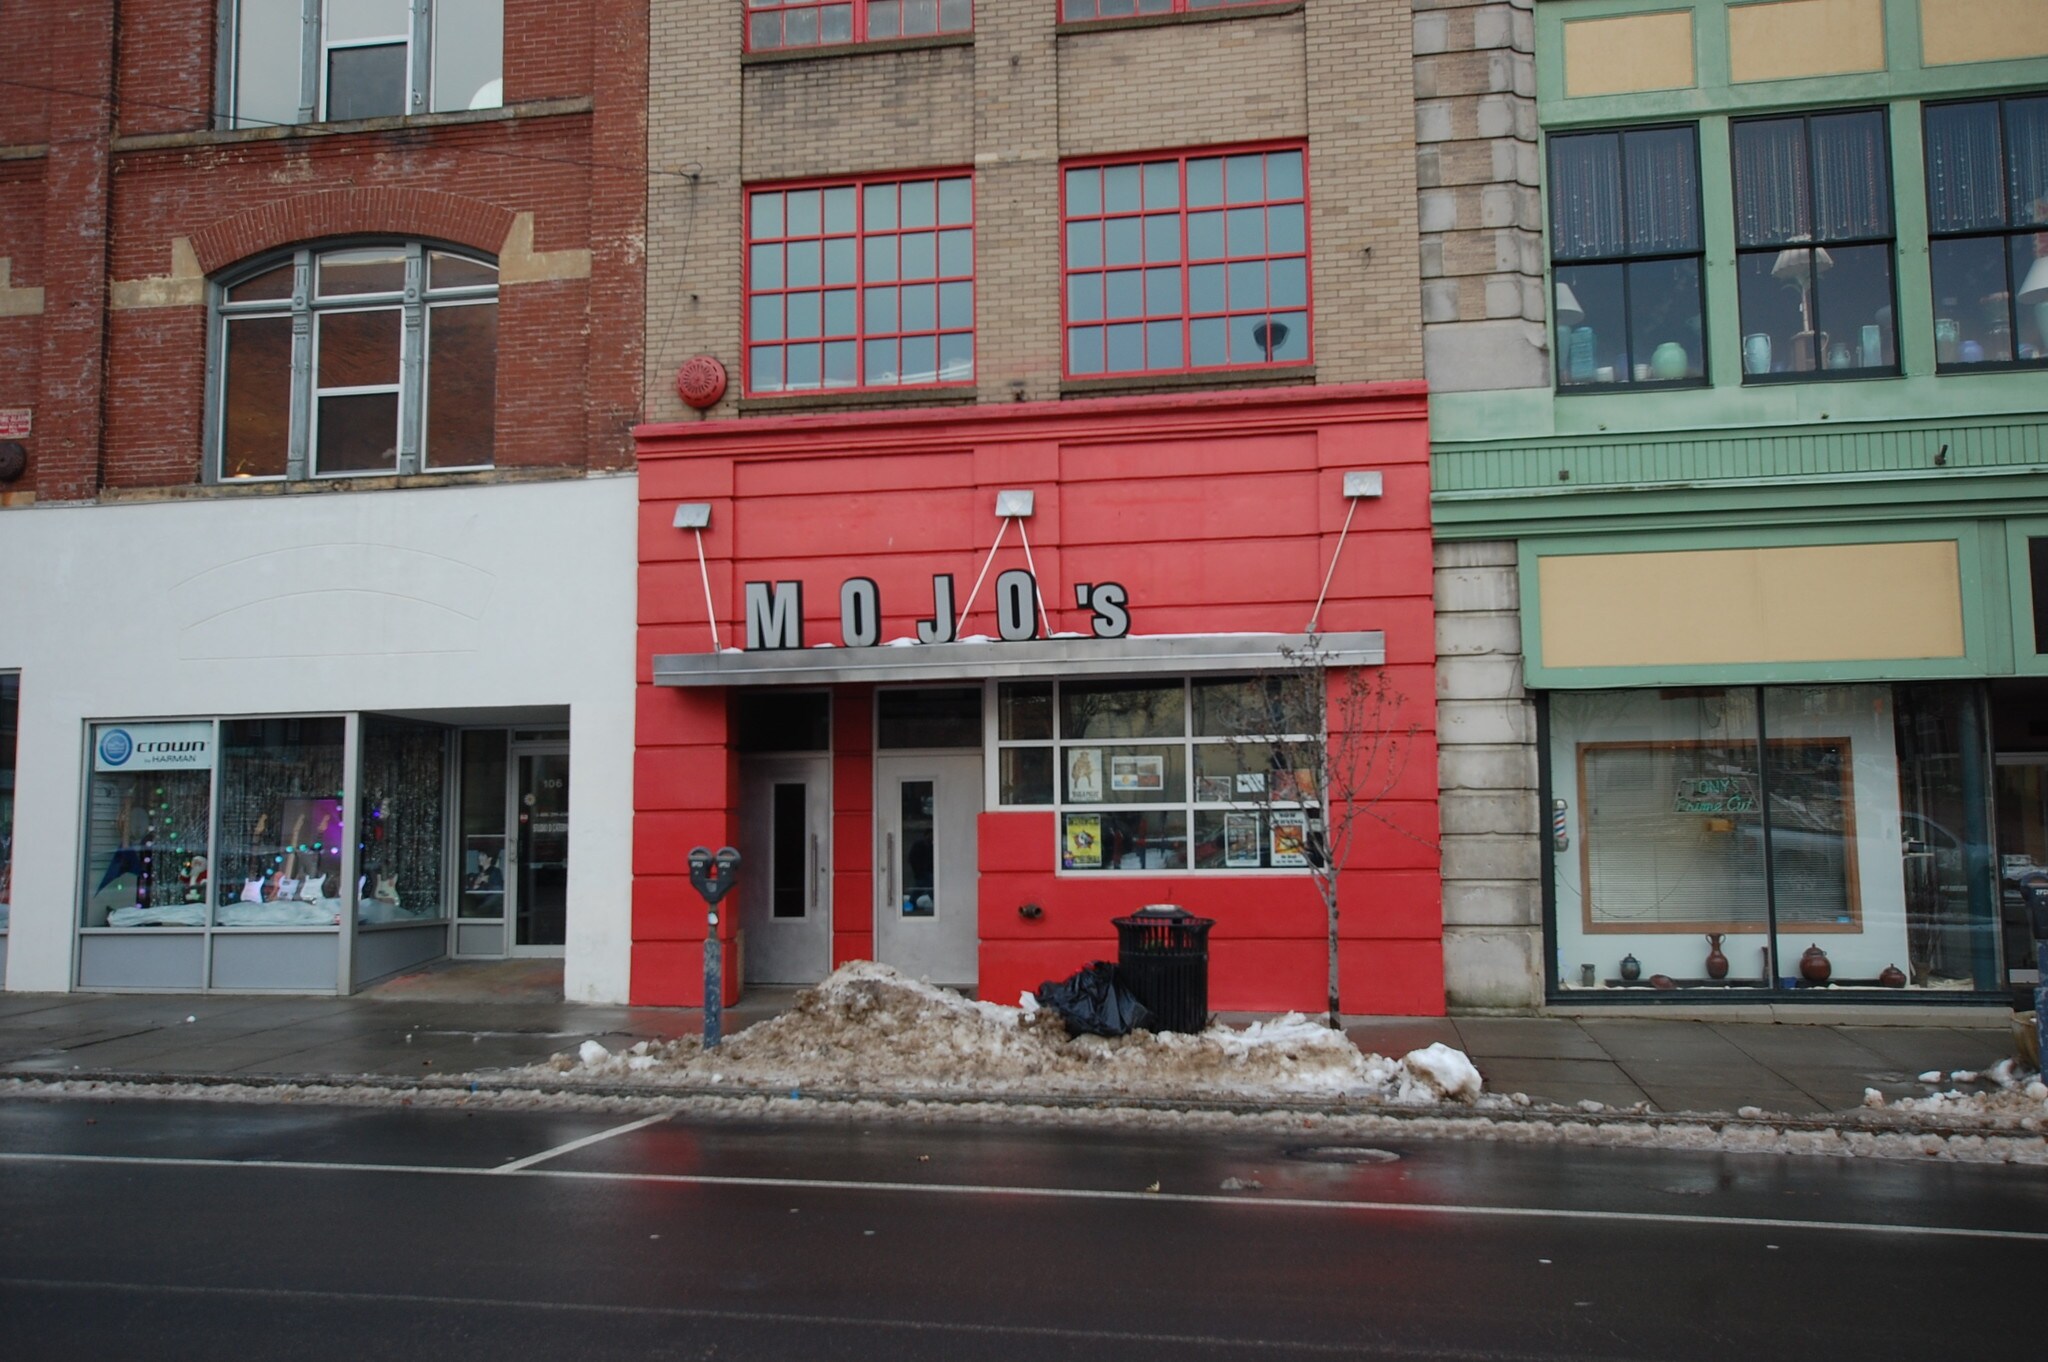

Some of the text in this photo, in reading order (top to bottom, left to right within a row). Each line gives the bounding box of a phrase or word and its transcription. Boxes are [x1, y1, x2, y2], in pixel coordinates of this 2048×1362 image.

[136, 741, 206, 753] crown
[152, 755, 197, 763] HARMAN
[1685, 777, 1741, 795] TONY'S
[1726, 795, 1754, 812] Cut
